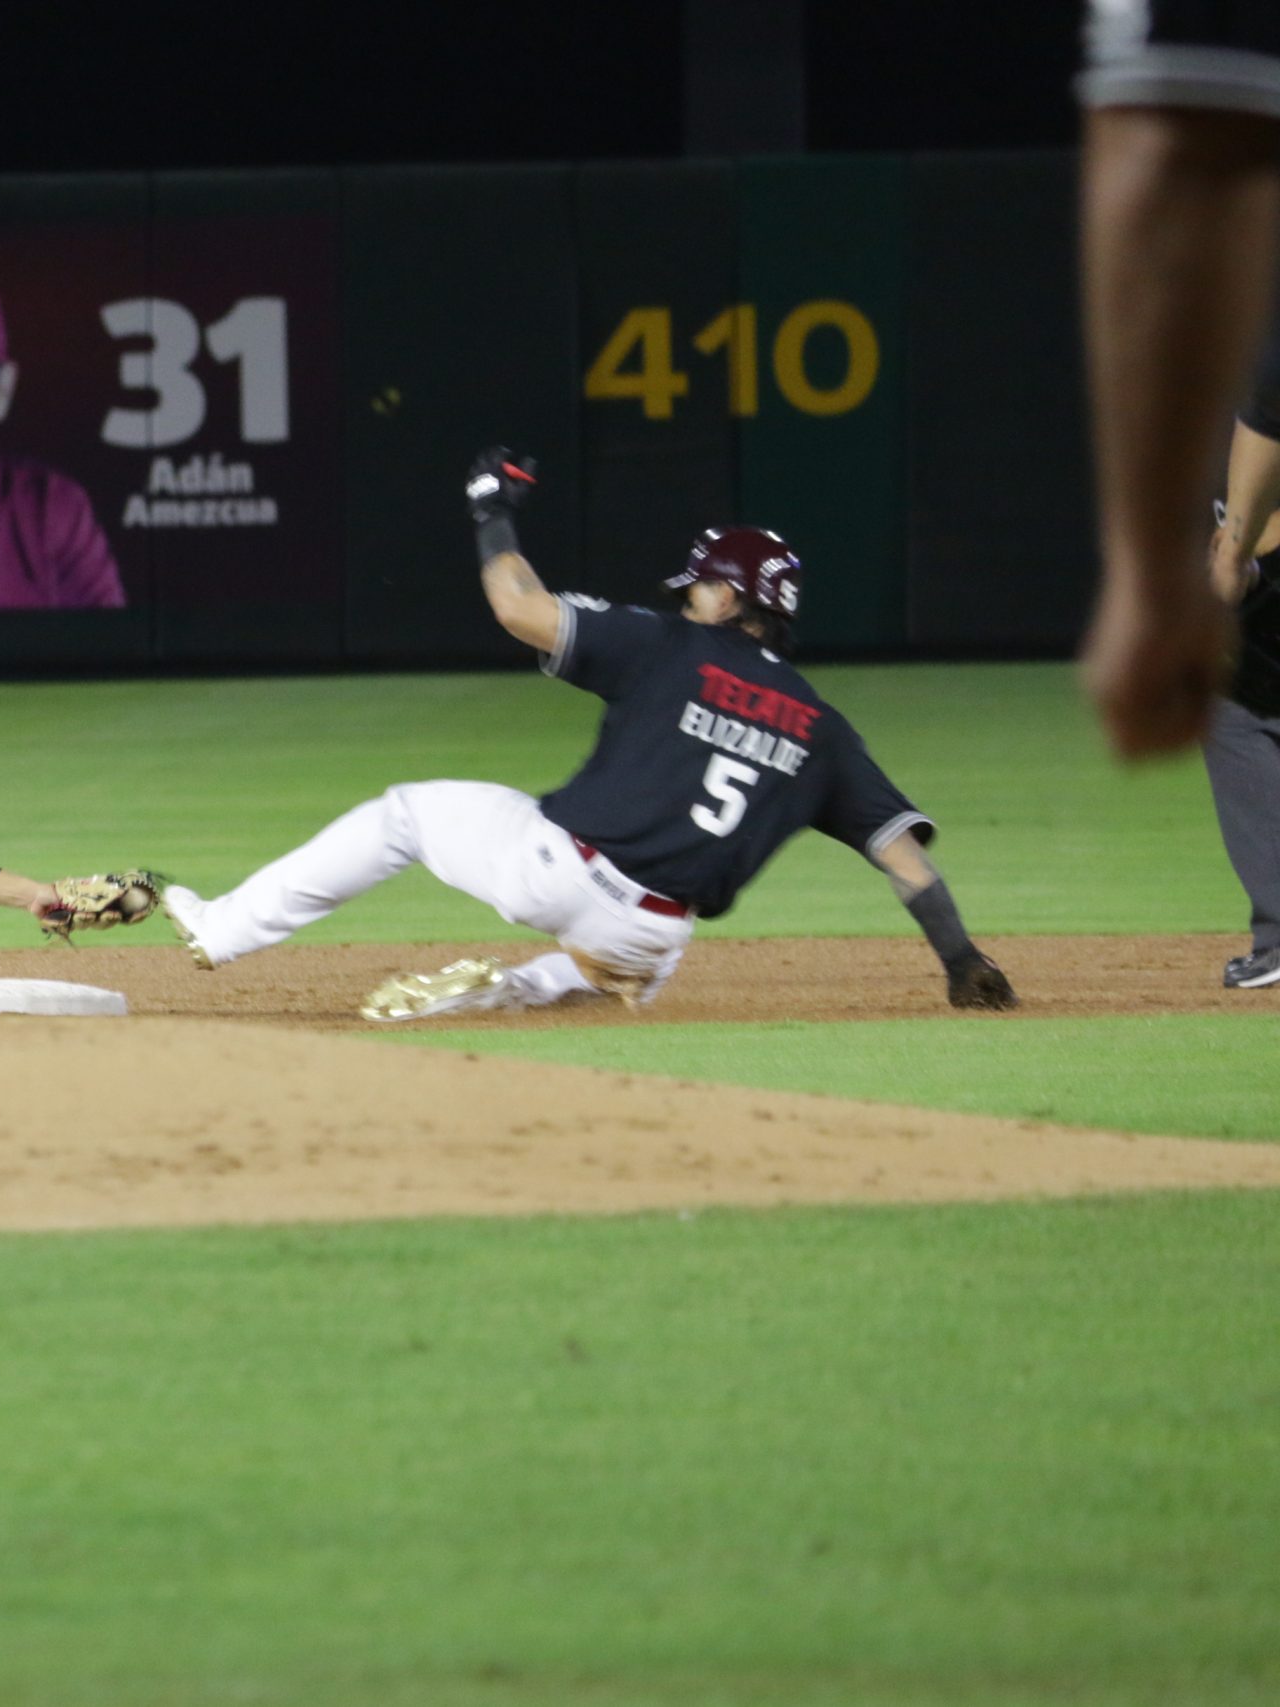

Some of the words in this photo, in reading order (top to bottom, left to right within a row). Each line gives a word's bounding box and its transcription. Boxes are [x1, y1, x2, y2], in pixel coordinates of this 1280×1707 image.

[100, 297, 289, 449] 31
[584, 300, 880, 420] 410
[123, 495, 278, 529] Amezcua
[149, 453, 253, 494] Adán
[678, 700, 810, 777] ELIZALDE
[698, 663, 822, 741] TECATE
[689, 752, 760, 838] 5
